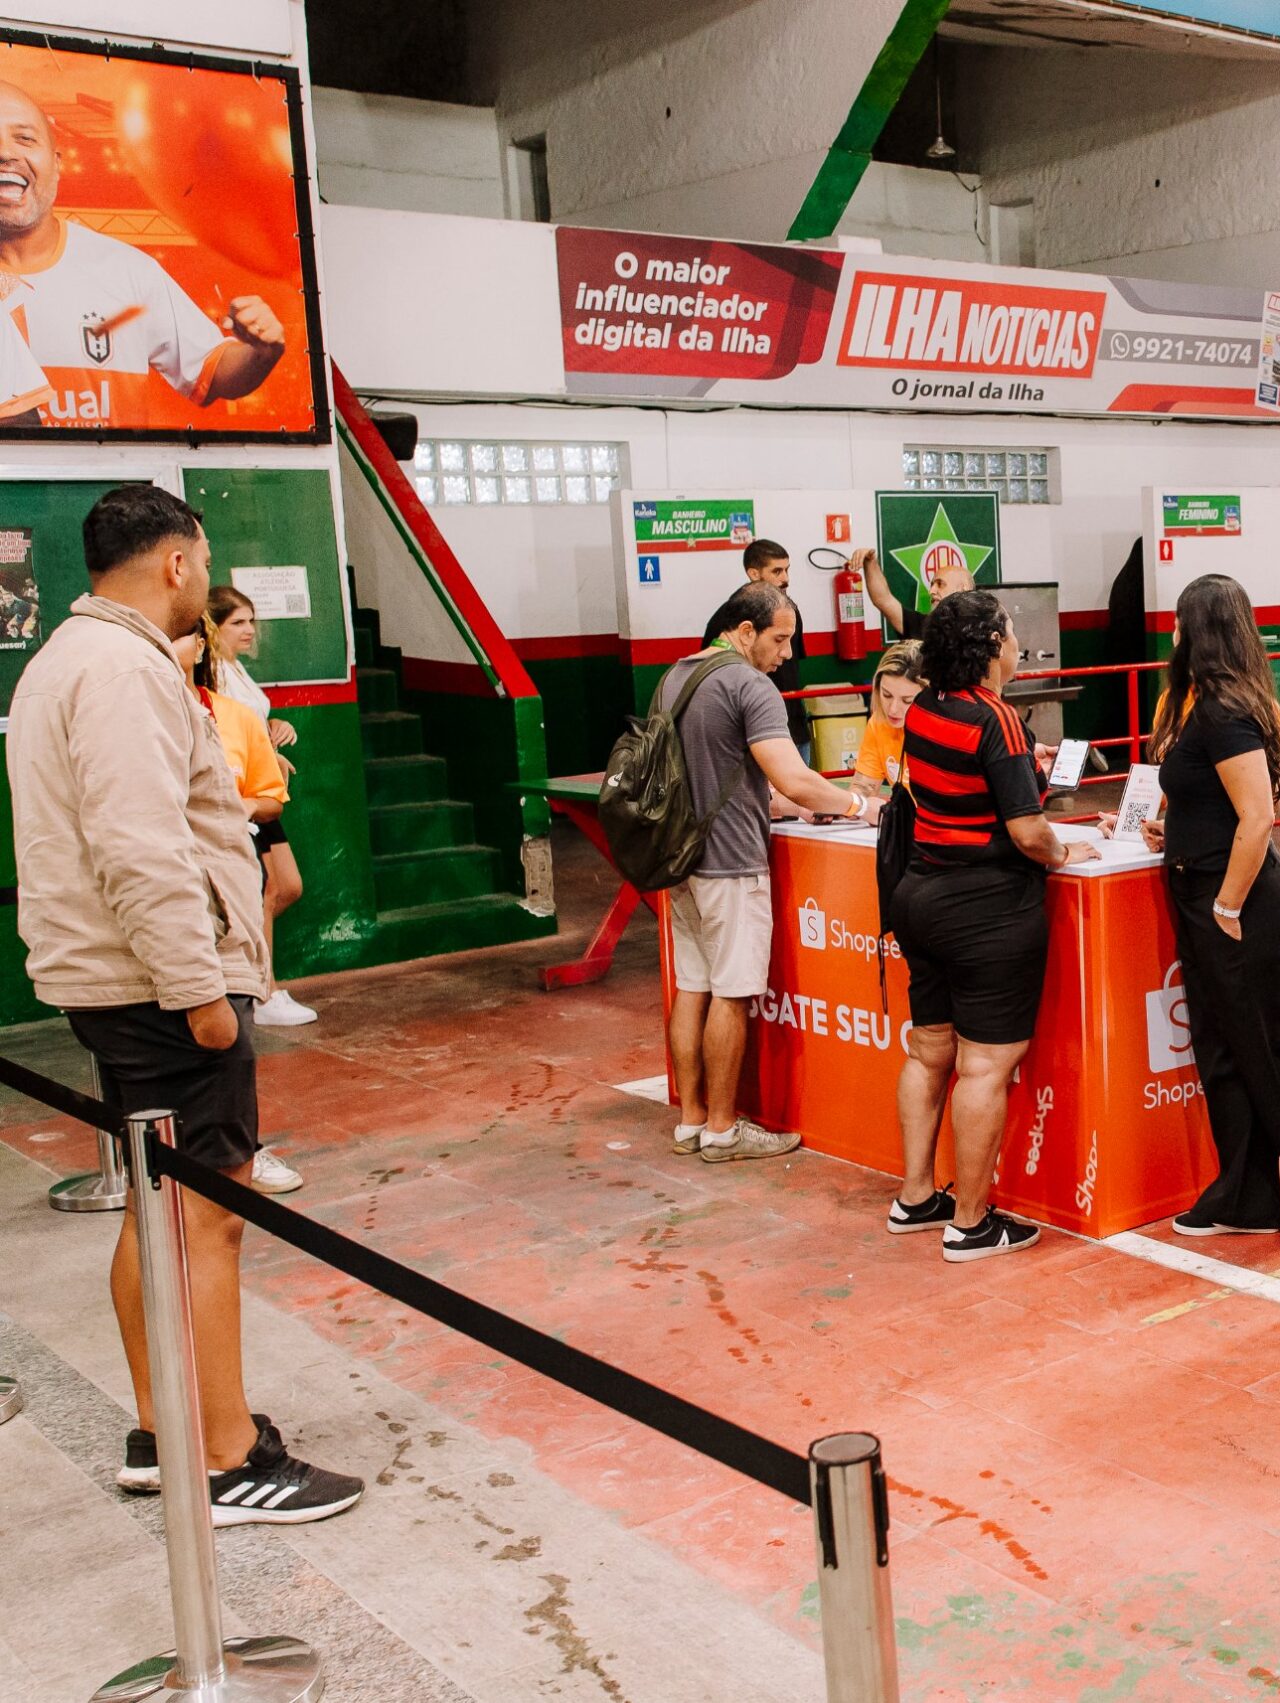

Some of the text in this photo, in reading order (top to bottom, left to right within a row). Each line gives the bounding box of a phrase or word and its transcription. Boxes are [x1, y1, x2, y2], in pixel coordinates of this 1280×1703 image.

[614, 251, 730, 286] O maior
[575, 282, 768, 322] influenciador
[574, 318, 771, 355] digital da Ilha
[847, 283, 960, 363] ILHA
[1132, 339, 1252, 364] 9921-74074
[38, 380, 110, 419] ual
[892, 378, 1045, 402] O jornal da Ilha
[651, 518, 727, 535] MASCULINO
[672, 510, 706, 519] BANHEIRO
[1178, 508, 1219, 520] FEMININO
[836, 1004, 891, 1050] SEU
[1025, 1085, 1054, 1176] Shopee
